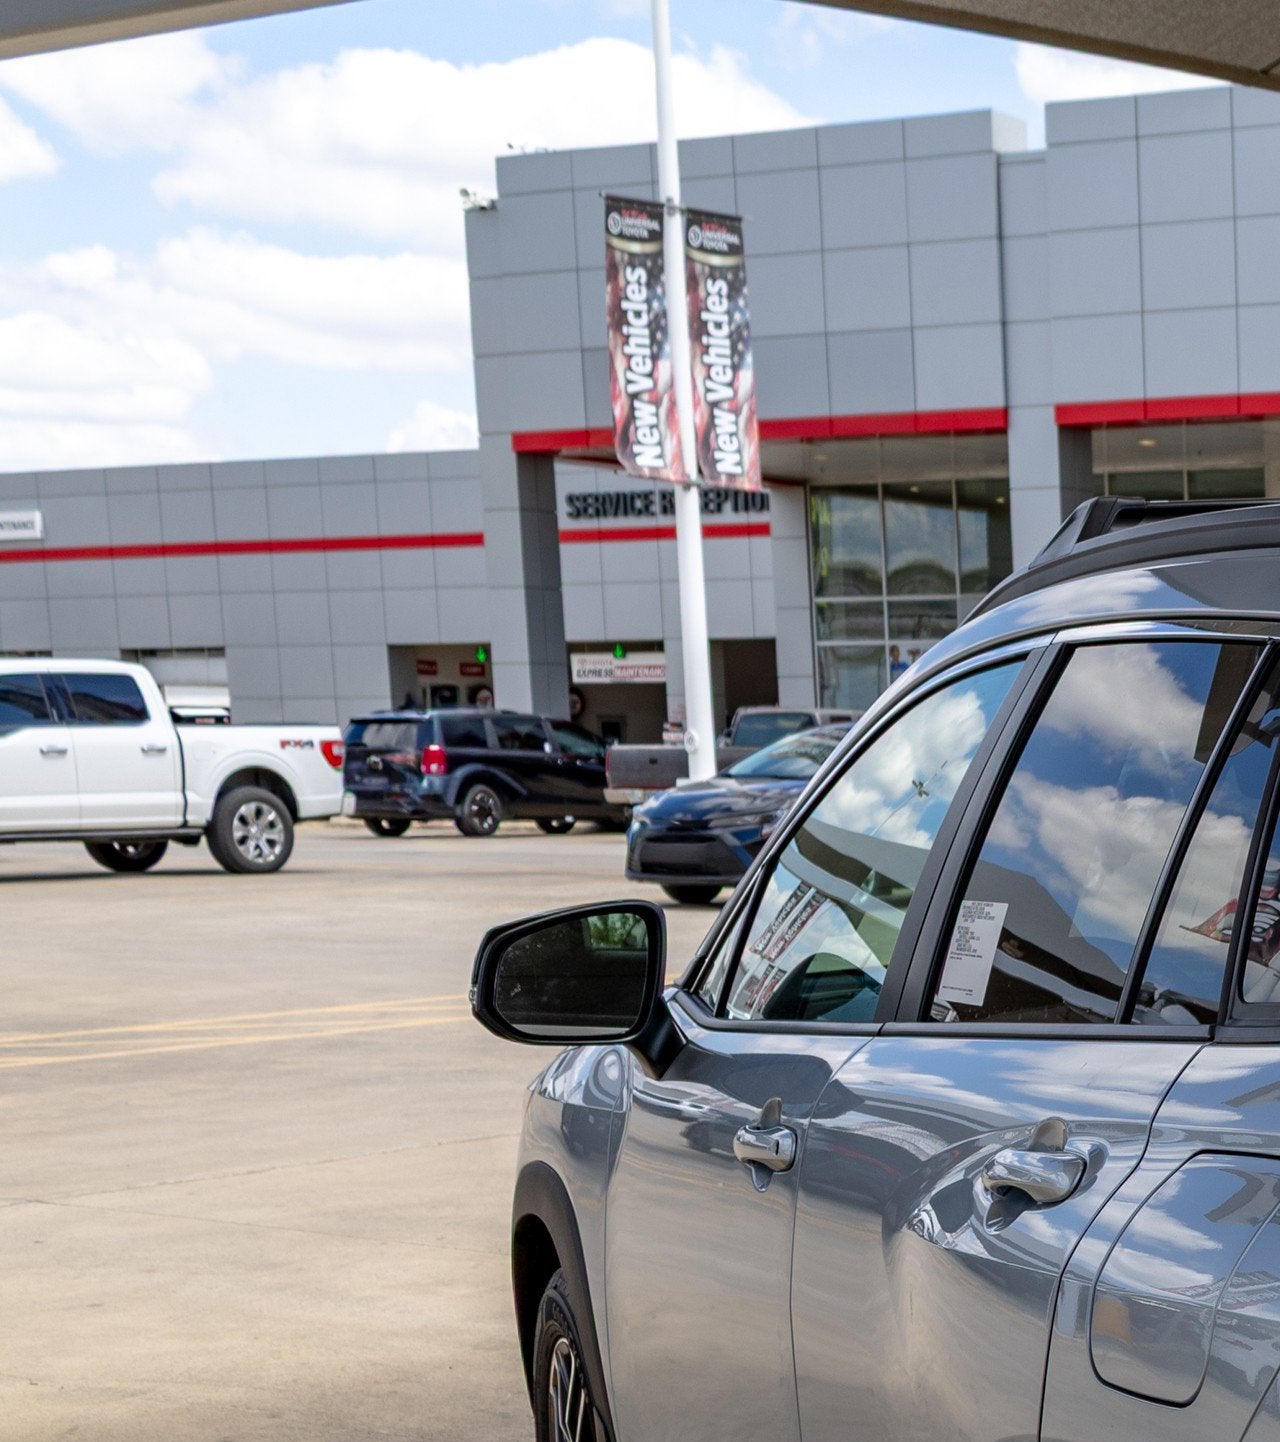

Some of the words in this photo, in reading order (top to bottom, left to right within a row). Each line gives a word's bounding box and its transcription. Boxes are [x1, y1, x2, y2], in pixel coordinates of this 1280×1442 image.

[620, 266, 655, 395] Vehicles
[700, 278, 735, 402] Vehicles
[633, 399, 665, 468] New
[713, 406, 743, 475] New
[565, 490, 656, 519] SERVICE
[658, 488, 770, 516] REPTIO
[576, 668, 613, 678] EXPRESS
